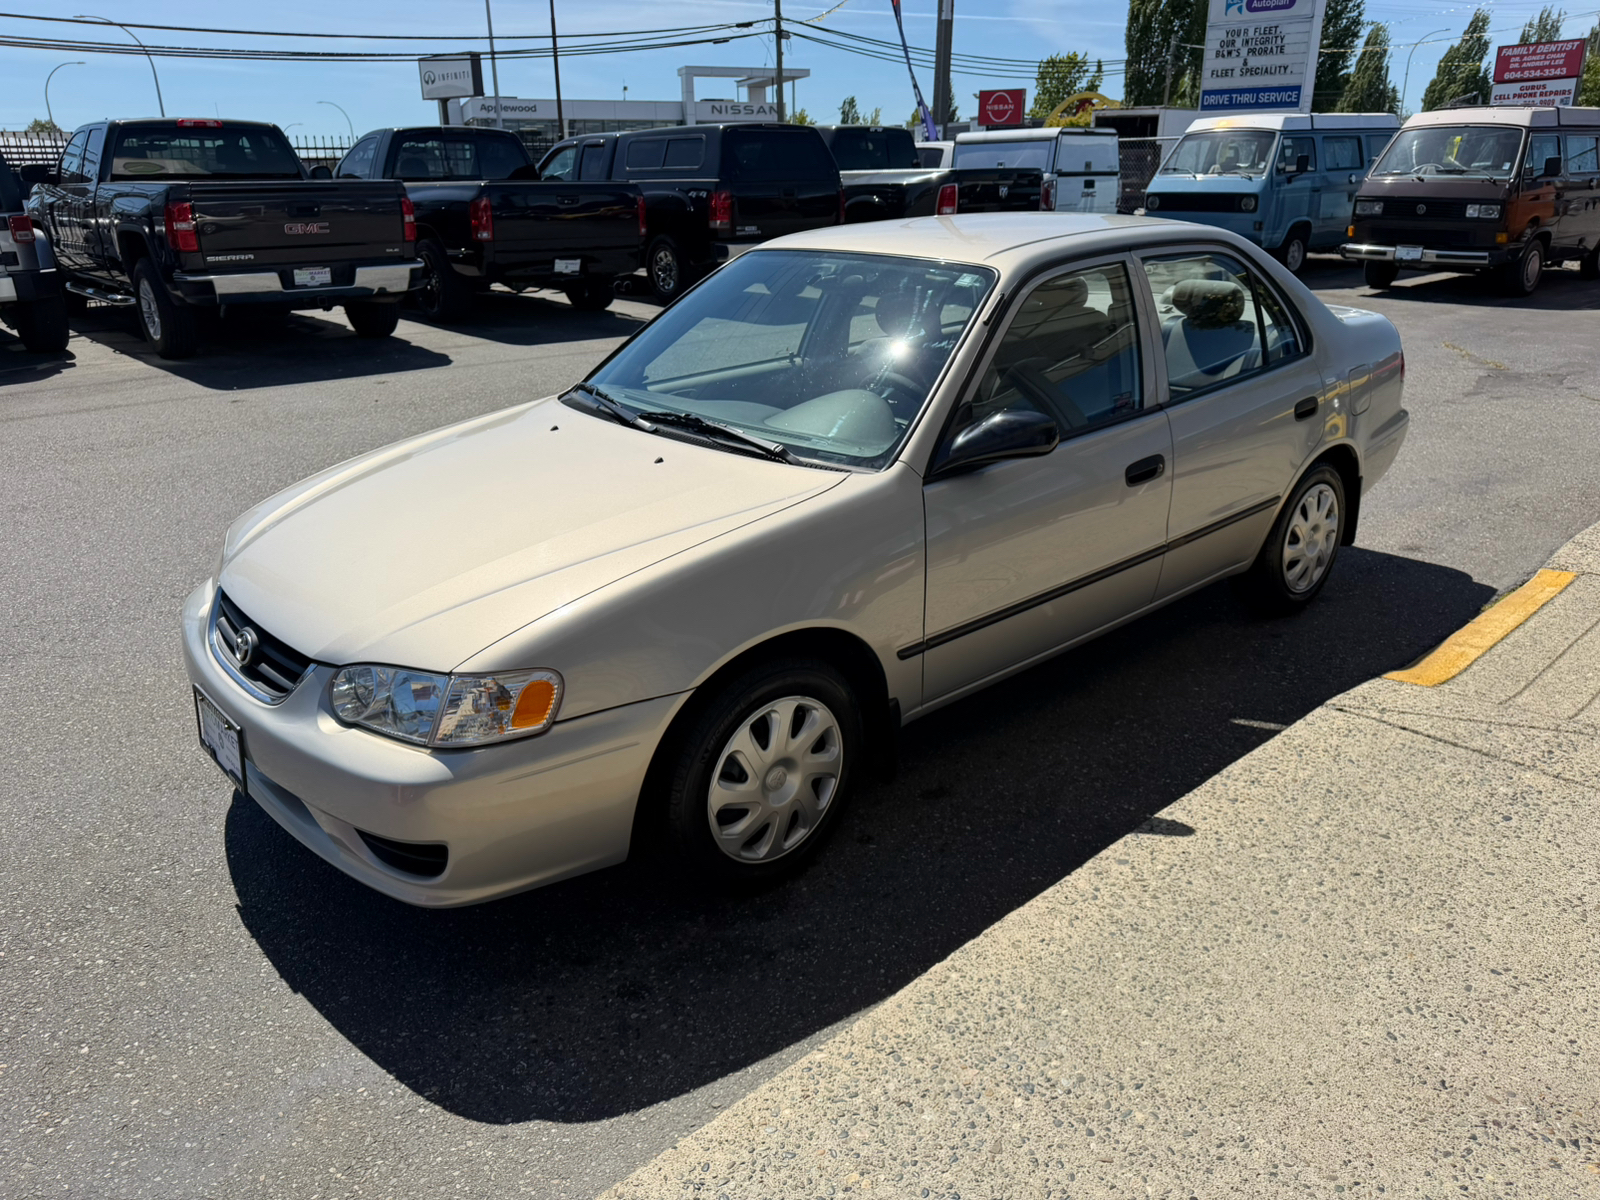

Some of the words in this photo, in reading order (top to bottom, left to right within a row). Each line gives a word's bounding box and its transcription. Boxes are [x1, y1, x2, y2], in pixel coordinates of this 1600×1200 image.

[1251, 0, 1290, 8] Autoplan
[1225, 28, 1249, 38] YOUR
[1253, 25, 1282, 35] FLEET.
[1219, 39, 1236, 48] OUR
[1241, 35, 1286, 47] INTEGRITY
[1215, 48, 1242, 58] B&W'S
[1246, 45, 1285, 56] PRORATE
[1501, 45, 1537, 57] FAMILY
[1536, 41, 1581, 54] DENTIST
[1242, 58, 1248, 67] &
[1521, 60, 1551, 68] ANDREW
[1522, 54, 1546, 62] AGNES
[437, 70, 470, 81] INFINITI
[1210, 68, 1235, 78] FLEET
[1239, 65, 1294, 77] SPECIALITY.
[1503, 67, 1567, 80] 604-534-3343
[1519, 84, 1547, 92] GURUS
[1203, 94, 1230, 105] DRIVE
[1231, 93, 1257, 104] THRU
[1258, 91, 1299, 103] SERVICE
[1494, 93, 1511, 101] CELL
[1512, 91, 1538, 99] PHONE
[1539, 89, 1572, 97] REPAIRS
[711, 104, 779, 115] NISSAN
[284, 222, 330, 235] GMC
[206, 254, 255, 262] SIERRA
